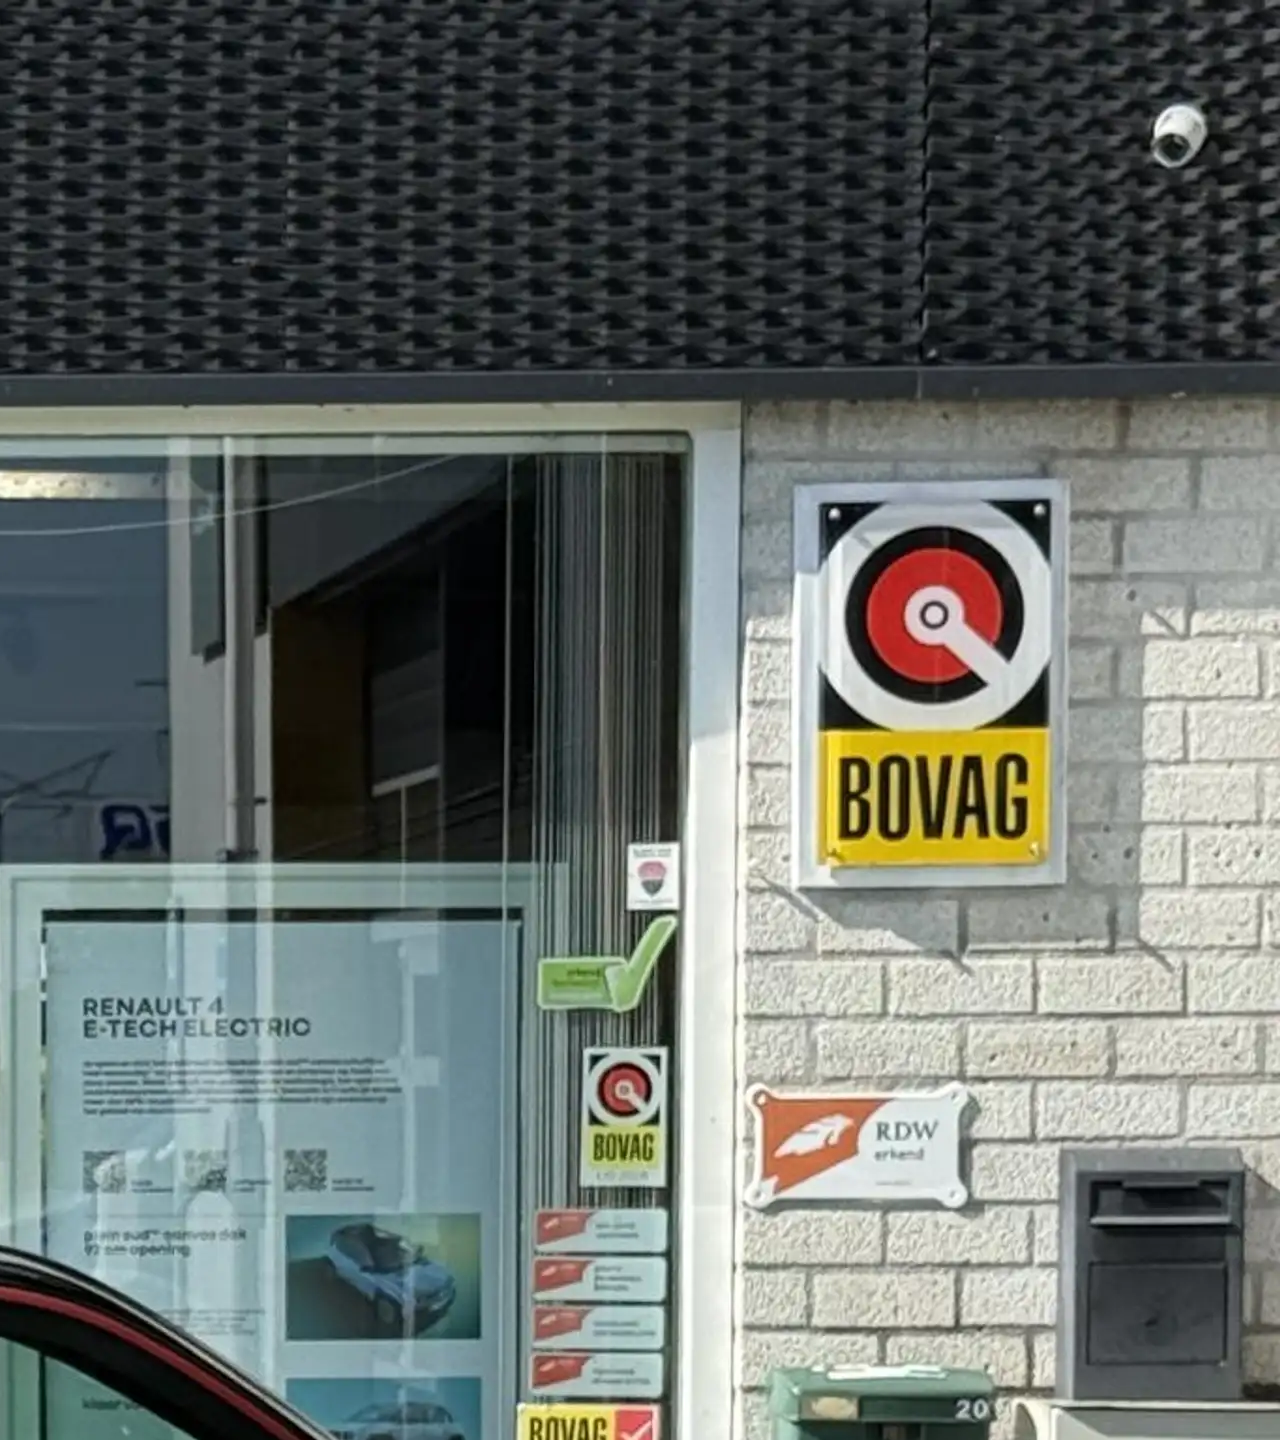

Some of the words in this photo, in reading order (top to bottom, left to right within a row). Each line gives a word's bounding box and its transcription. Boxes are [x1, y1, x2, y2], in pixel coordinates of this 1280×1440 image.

[839, 753, 1029, 841] BOVAG
[82, 997, 204, 1017] RENAULT
[208, 997, 224, 1016] 4
[83, 1018, 177, 1038] E-TECH
[183, 1018, 312, 1038] ELECTRIC
[876, 1119, 940, 1141] RDW
[593, 1133, 655, 1162] BOVAG
[874, 1147, 925, 1161] erkend
[955, 1400, 989, 1419] 20
